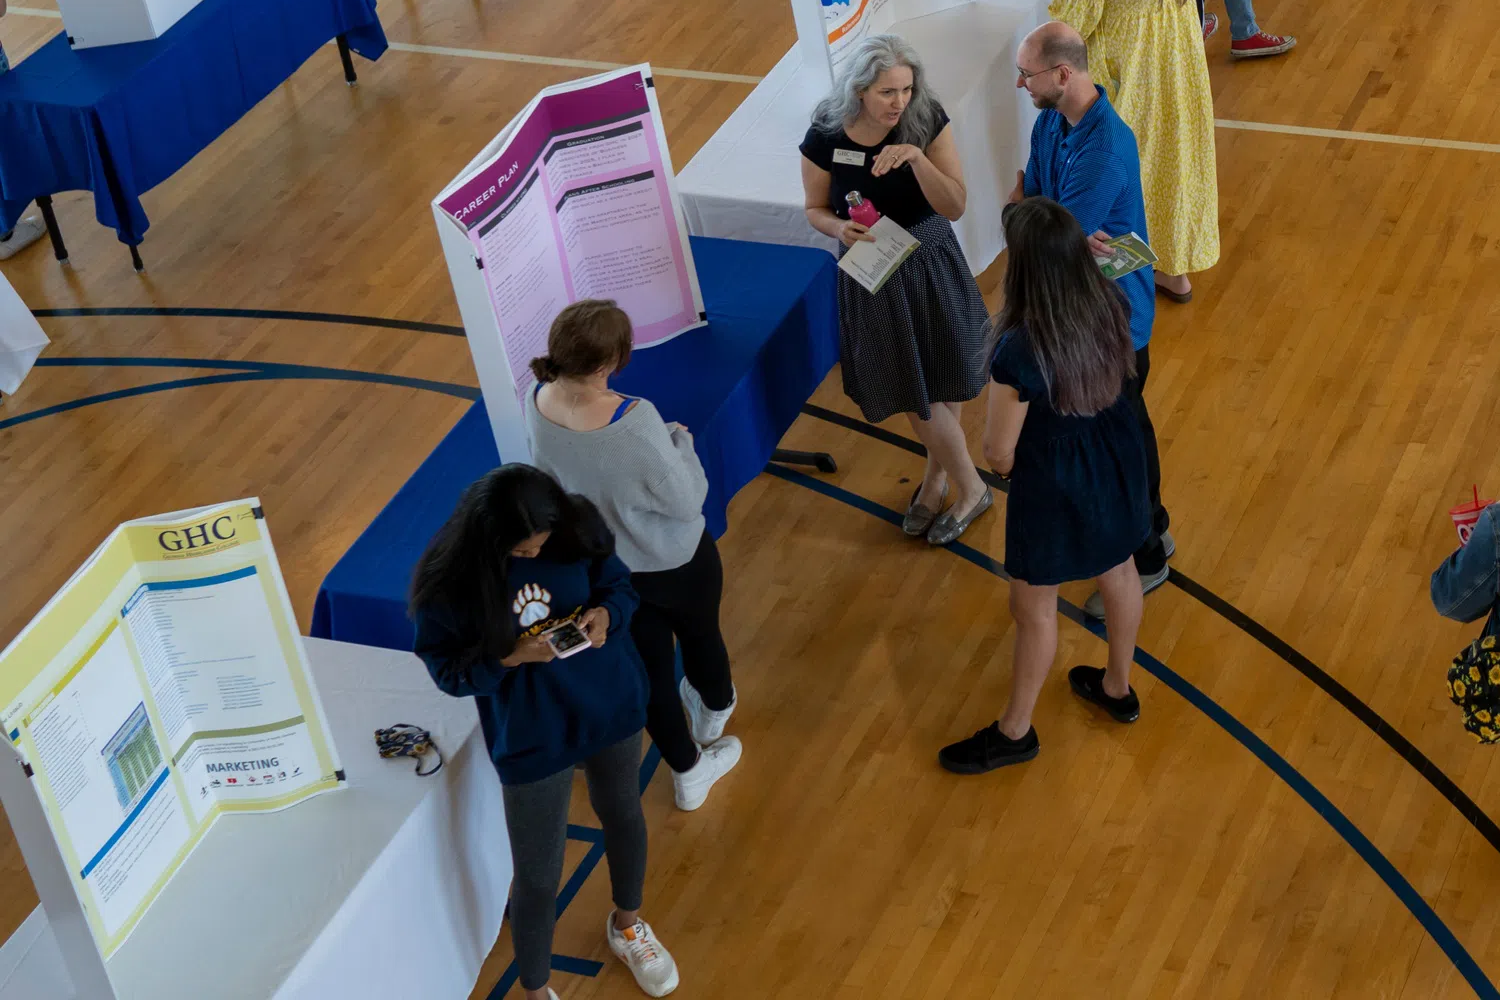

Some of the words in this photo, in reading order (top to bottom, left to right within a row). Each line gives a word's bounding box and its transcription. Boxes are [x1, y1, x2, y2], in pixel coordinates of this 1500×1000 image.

[566, 135, 604, 146] GRADUATION
[454, 184, 497, 220] CAREER
[497, 161, 519, 188] PLAN
[581, 187, 600, 195] AFTER
[601, 178, 635, 190] SCHOOLING
[159, 516, 235, 551] GHC
[206, 757, 280, 773] MARKETING
